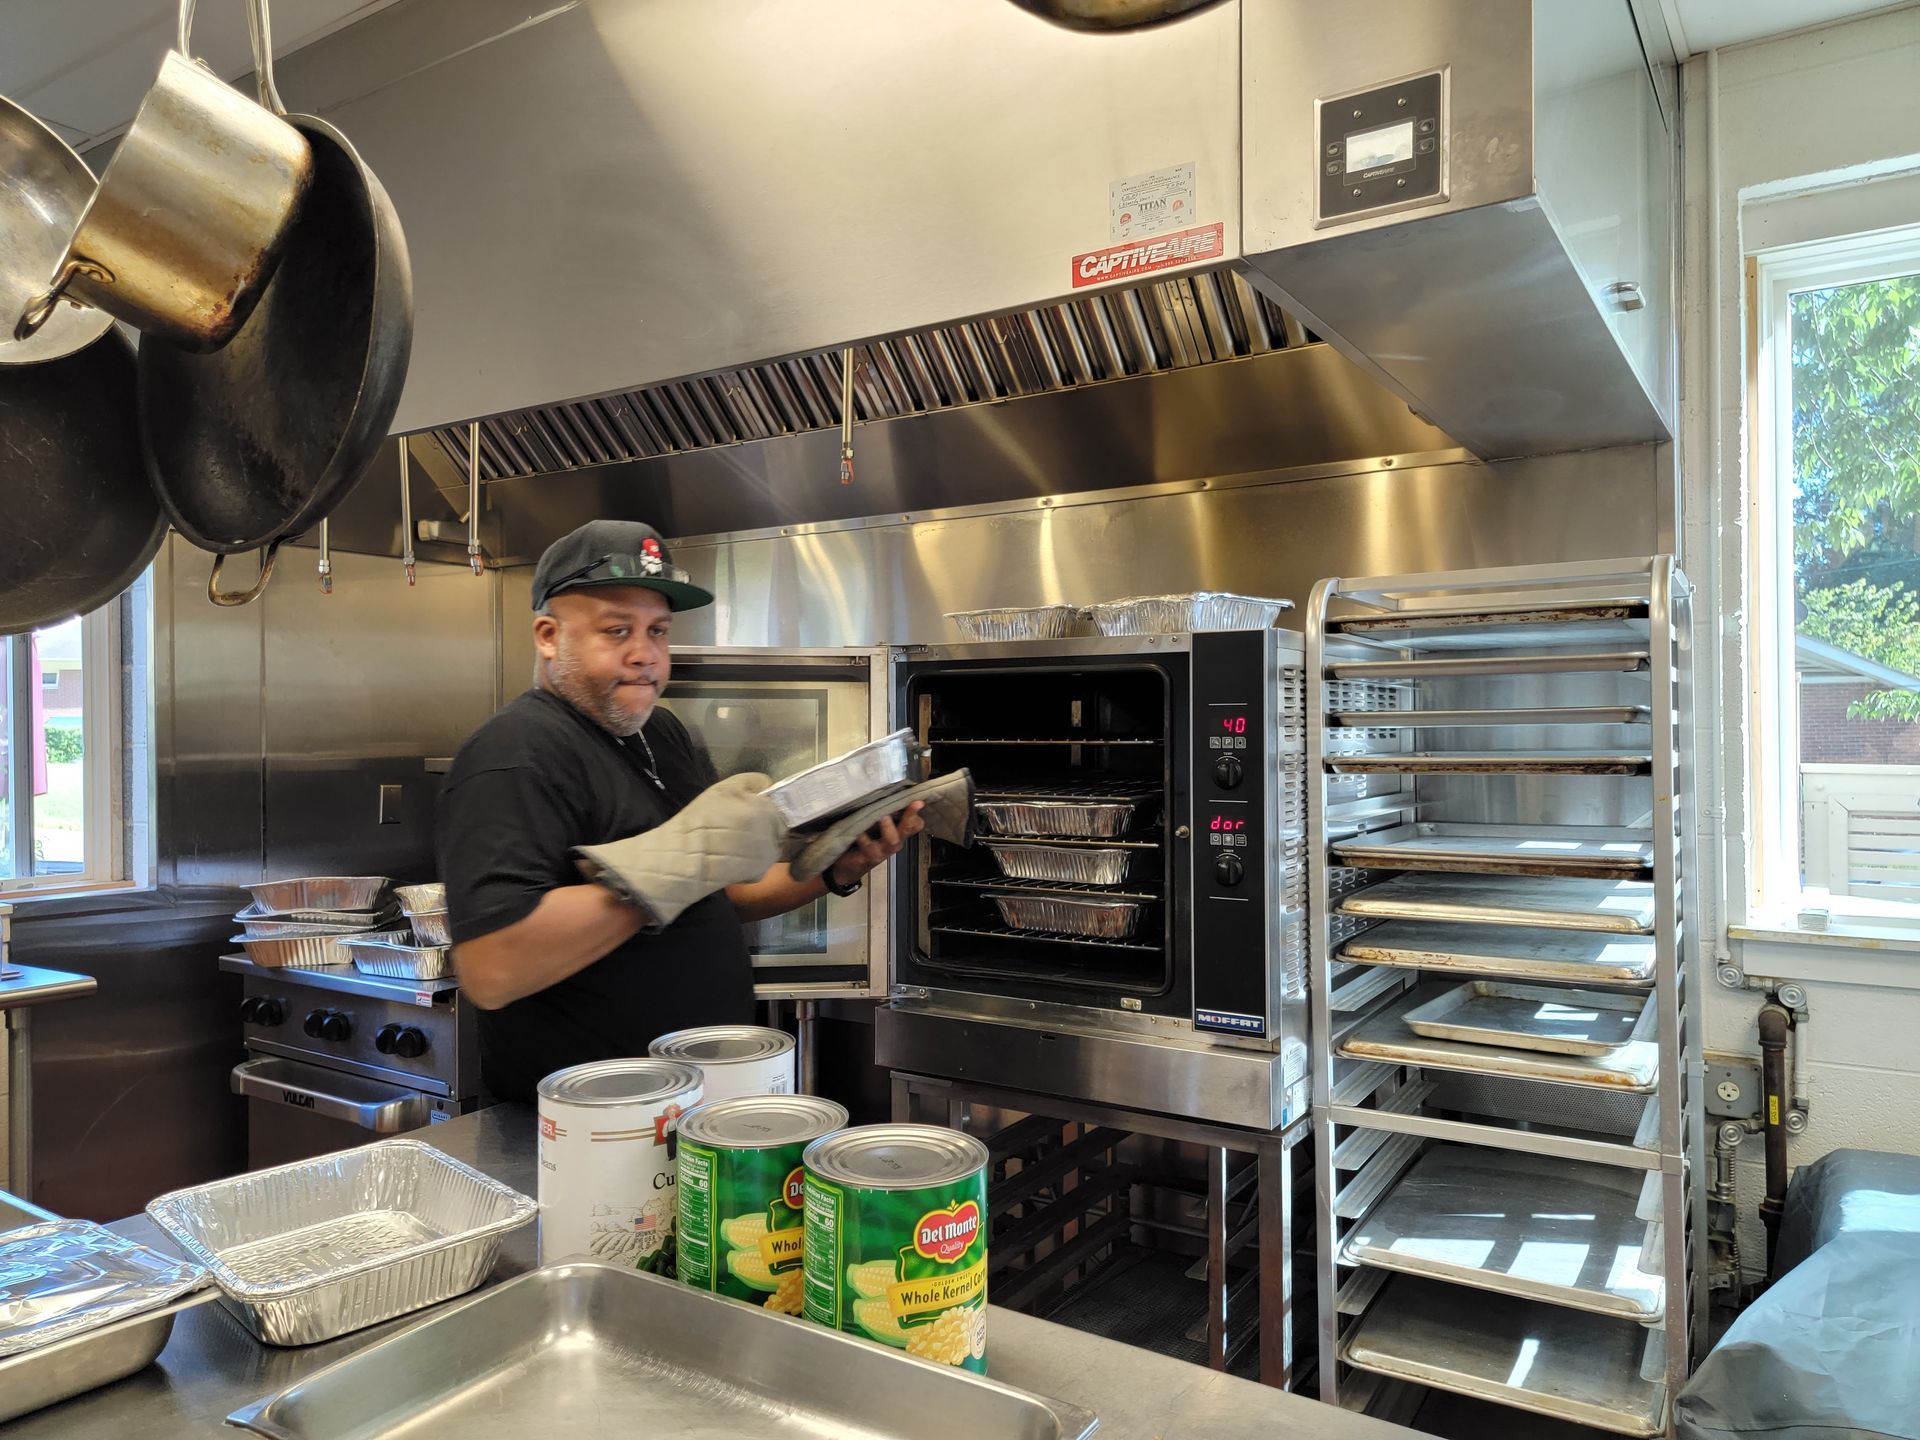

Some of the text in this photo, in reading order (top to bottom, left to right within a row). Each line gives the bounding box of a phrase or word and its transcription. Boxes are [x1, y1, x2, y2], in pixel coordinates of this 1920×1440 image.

[1138, 199, 1167, 211] TITAN
[1223, 718, 1246, 733] 40
[1210, 816, 1245, 830] dor
[1198, 1014, 1261, 1028] MOFFAT
[653, 1172, 675, 1189] Cu
[699, 1179, 708, 1188] 60
[824, 1217, 834, 1228] 60
[921, 1215, 977, 1245] Del Monte
[772, 1236, 802, 1254] Whol
[940, 1240, 965, 1254] Quality
[900, 1289, 940, 1306] Whole
[942, 1276, 973, 1300] Kernel
